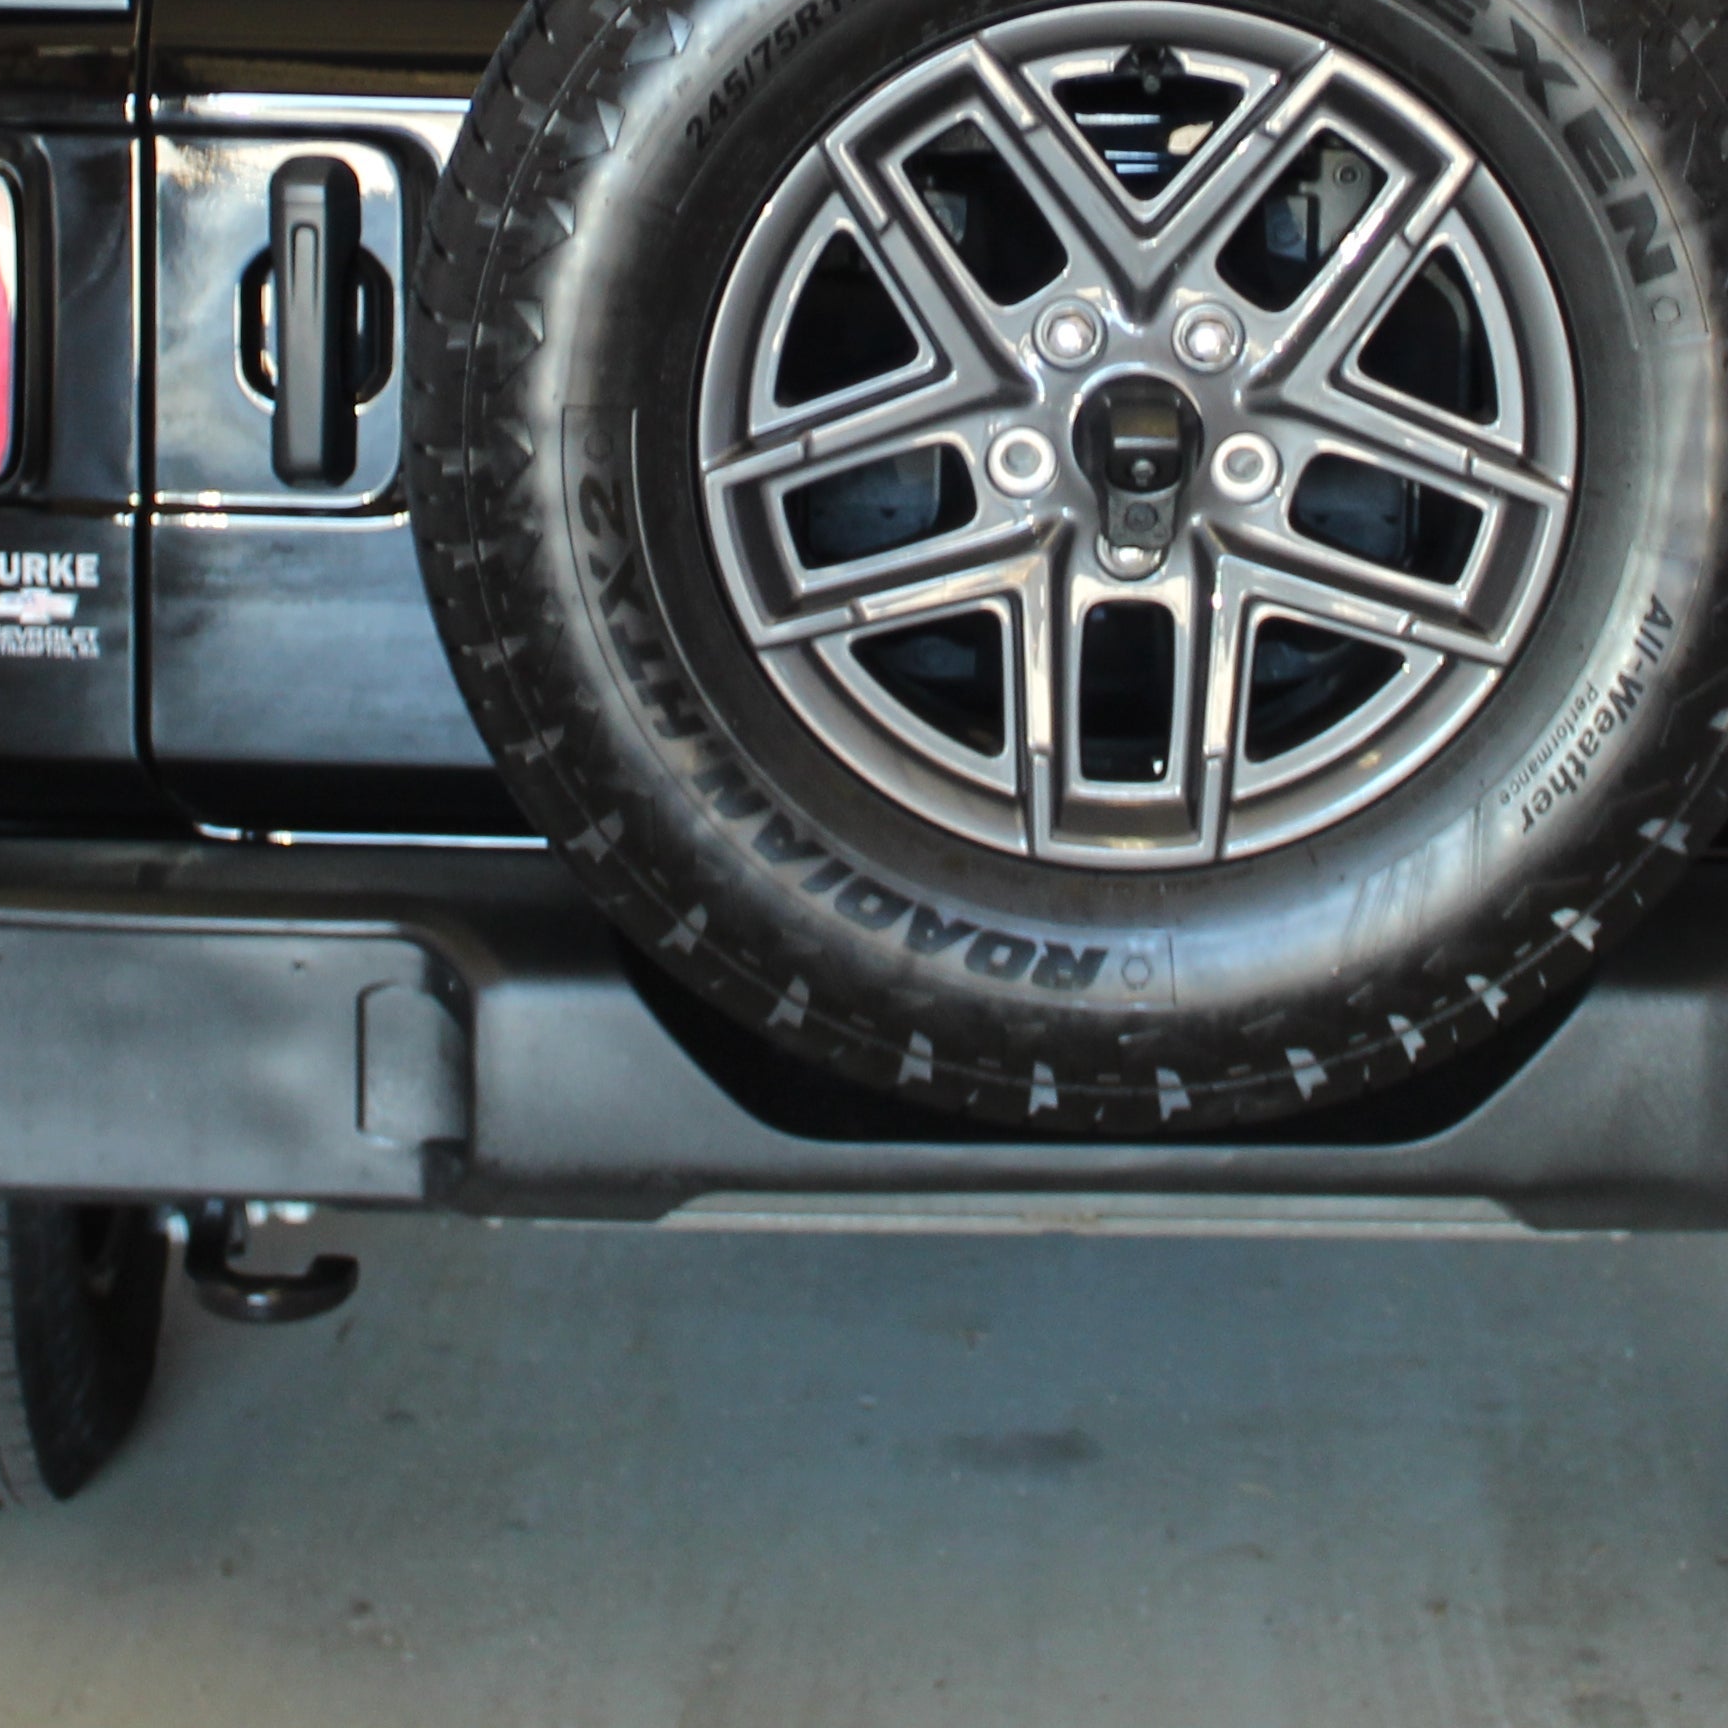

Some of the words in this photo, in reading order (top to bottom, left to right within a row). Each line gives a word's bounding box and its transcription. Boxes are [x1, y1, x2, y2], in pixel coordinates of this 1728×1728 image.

[1498, 681, 1600, 806] Performance
[1521, 593, 1674, 834] All-Weather
[690, 770, 1109, 991] ROADIAN
